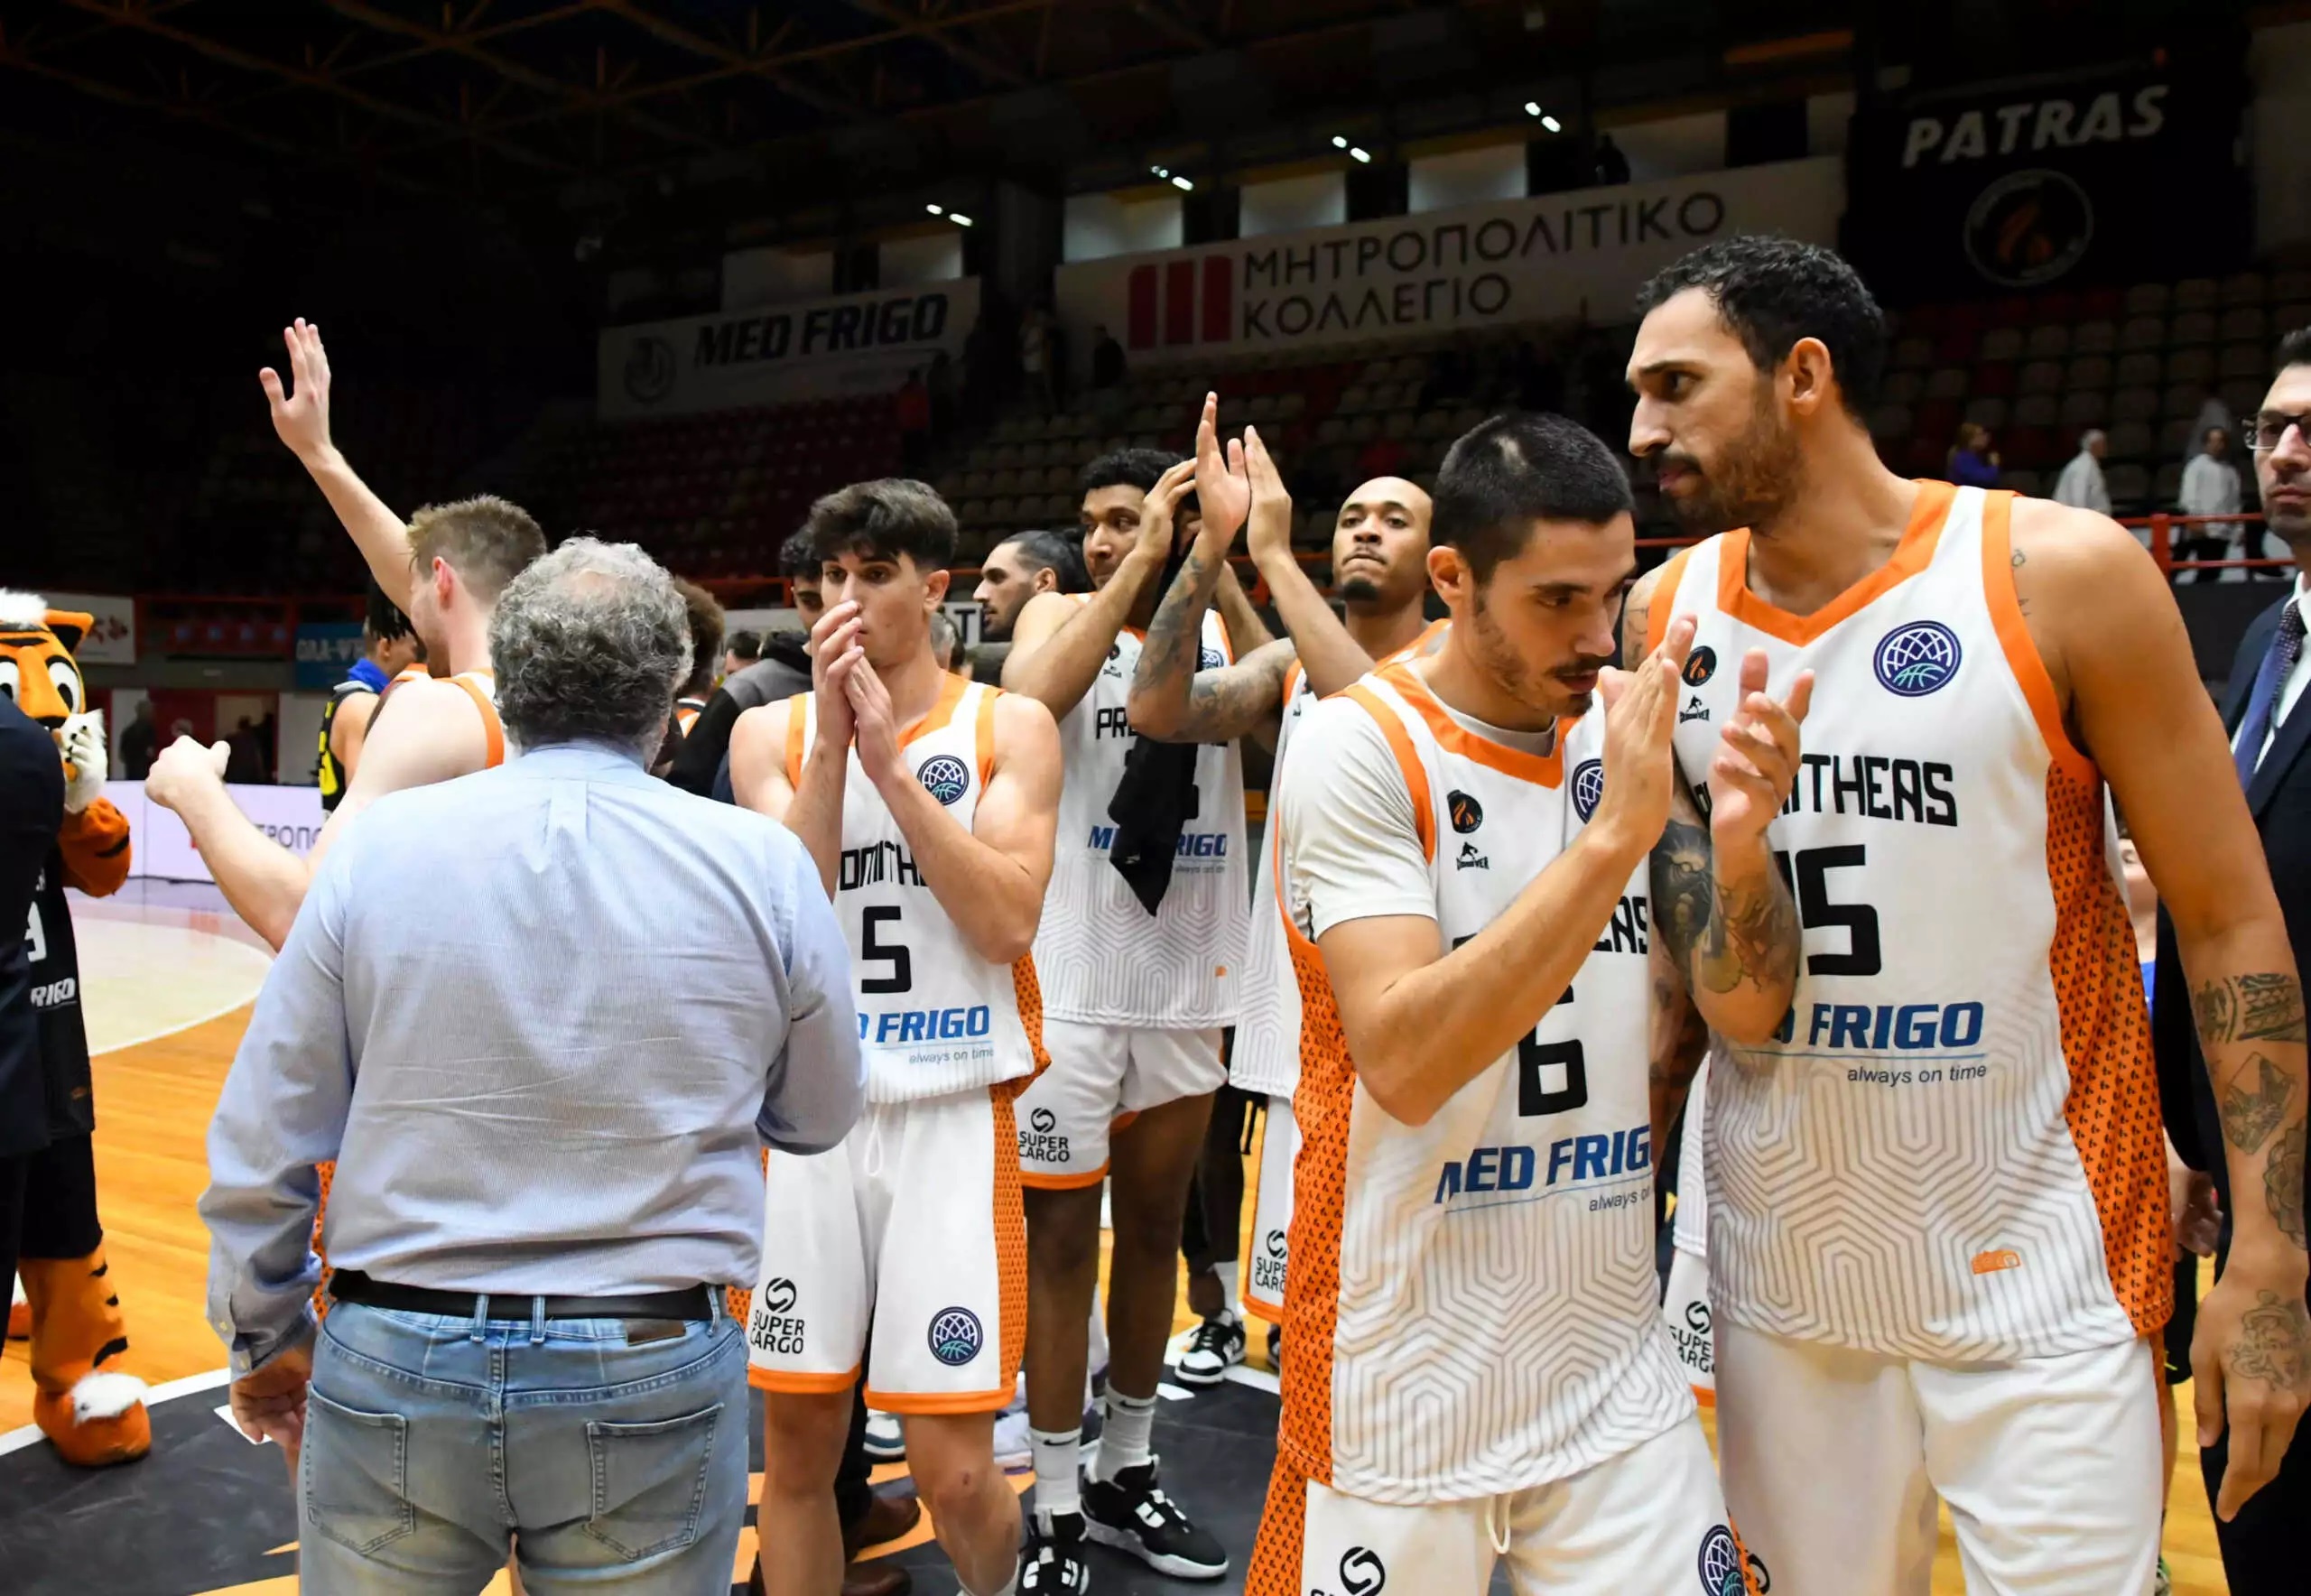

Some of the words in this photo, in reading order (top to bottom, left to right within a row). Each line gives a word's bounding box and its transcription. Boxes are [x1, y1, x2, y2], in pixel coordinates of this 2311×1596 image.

[1900, 84, 2171, 170] PATRAS
[1243, 192, 1724, 288] ΜΗΤΡΟΠΟΛΙΤΙΚΟ
[695, 315, 792, 367] MED
[801, 293, 948, 354] FRIGO
[1243, 274, 1511, 339] ΚΟΛΛΕΓΙΟ
[861, 906, 912, 994] 5
[876, 1005, 989, 1043] FRIGO
[1517, 985, 1588, 1117] 6
[1808, 1001, 1984, 1050] FRIGO
[1847, 1067, 1912, 1088] always
[1918, 1071, 1942, 1082] on
[1949, 1065, 1987, 1080] time
[1018, 1131, 1069, 1150] SUPER
[1589, 1189, 1638, 1211] always
[753, 1309, 805, 1336] SUPER
